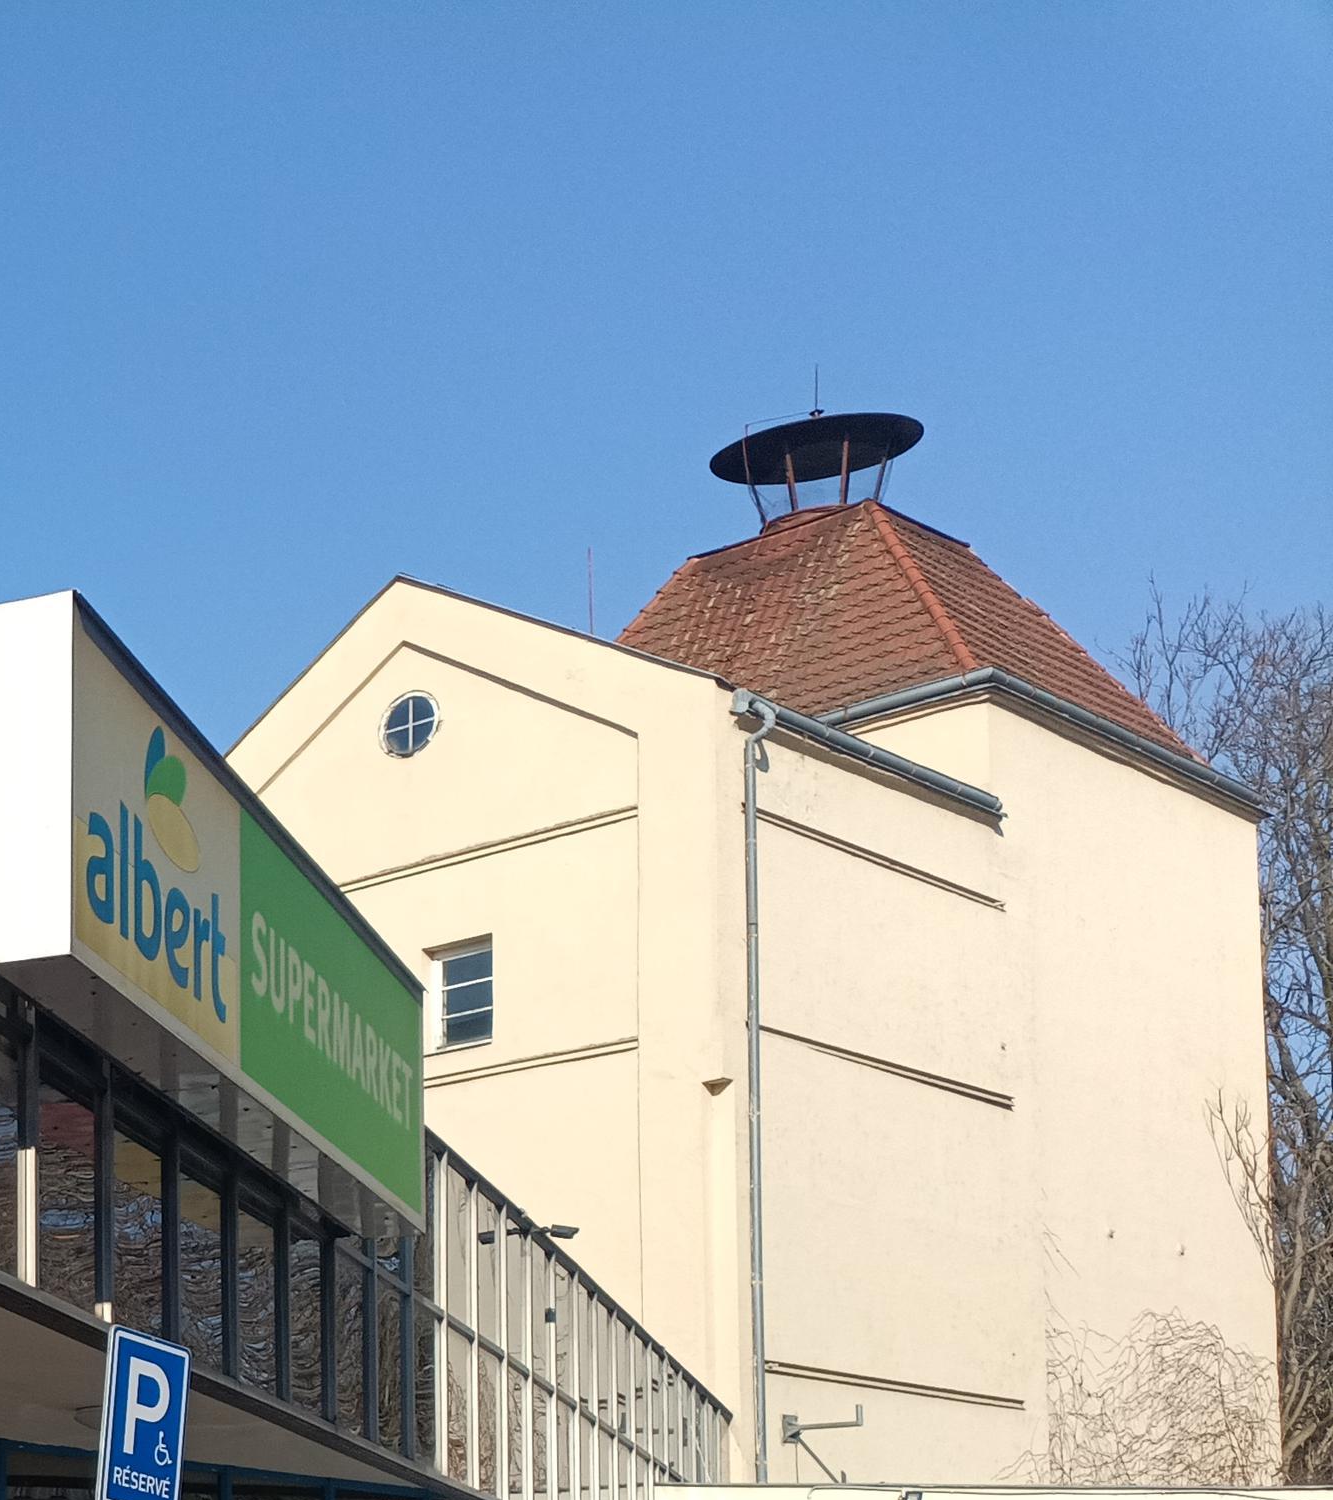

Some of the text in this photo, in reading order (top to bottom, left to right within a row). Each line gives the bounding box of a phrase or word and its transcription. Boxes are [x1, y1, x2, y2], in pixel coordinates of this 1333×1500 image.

[86, 800, 227, 1024] albert
[251, 911, 413, 1130] SUPERMARKET
[113, 1465, 171, 1499] RÉSERVÉ
[123, 1356, 171, 1455] P
